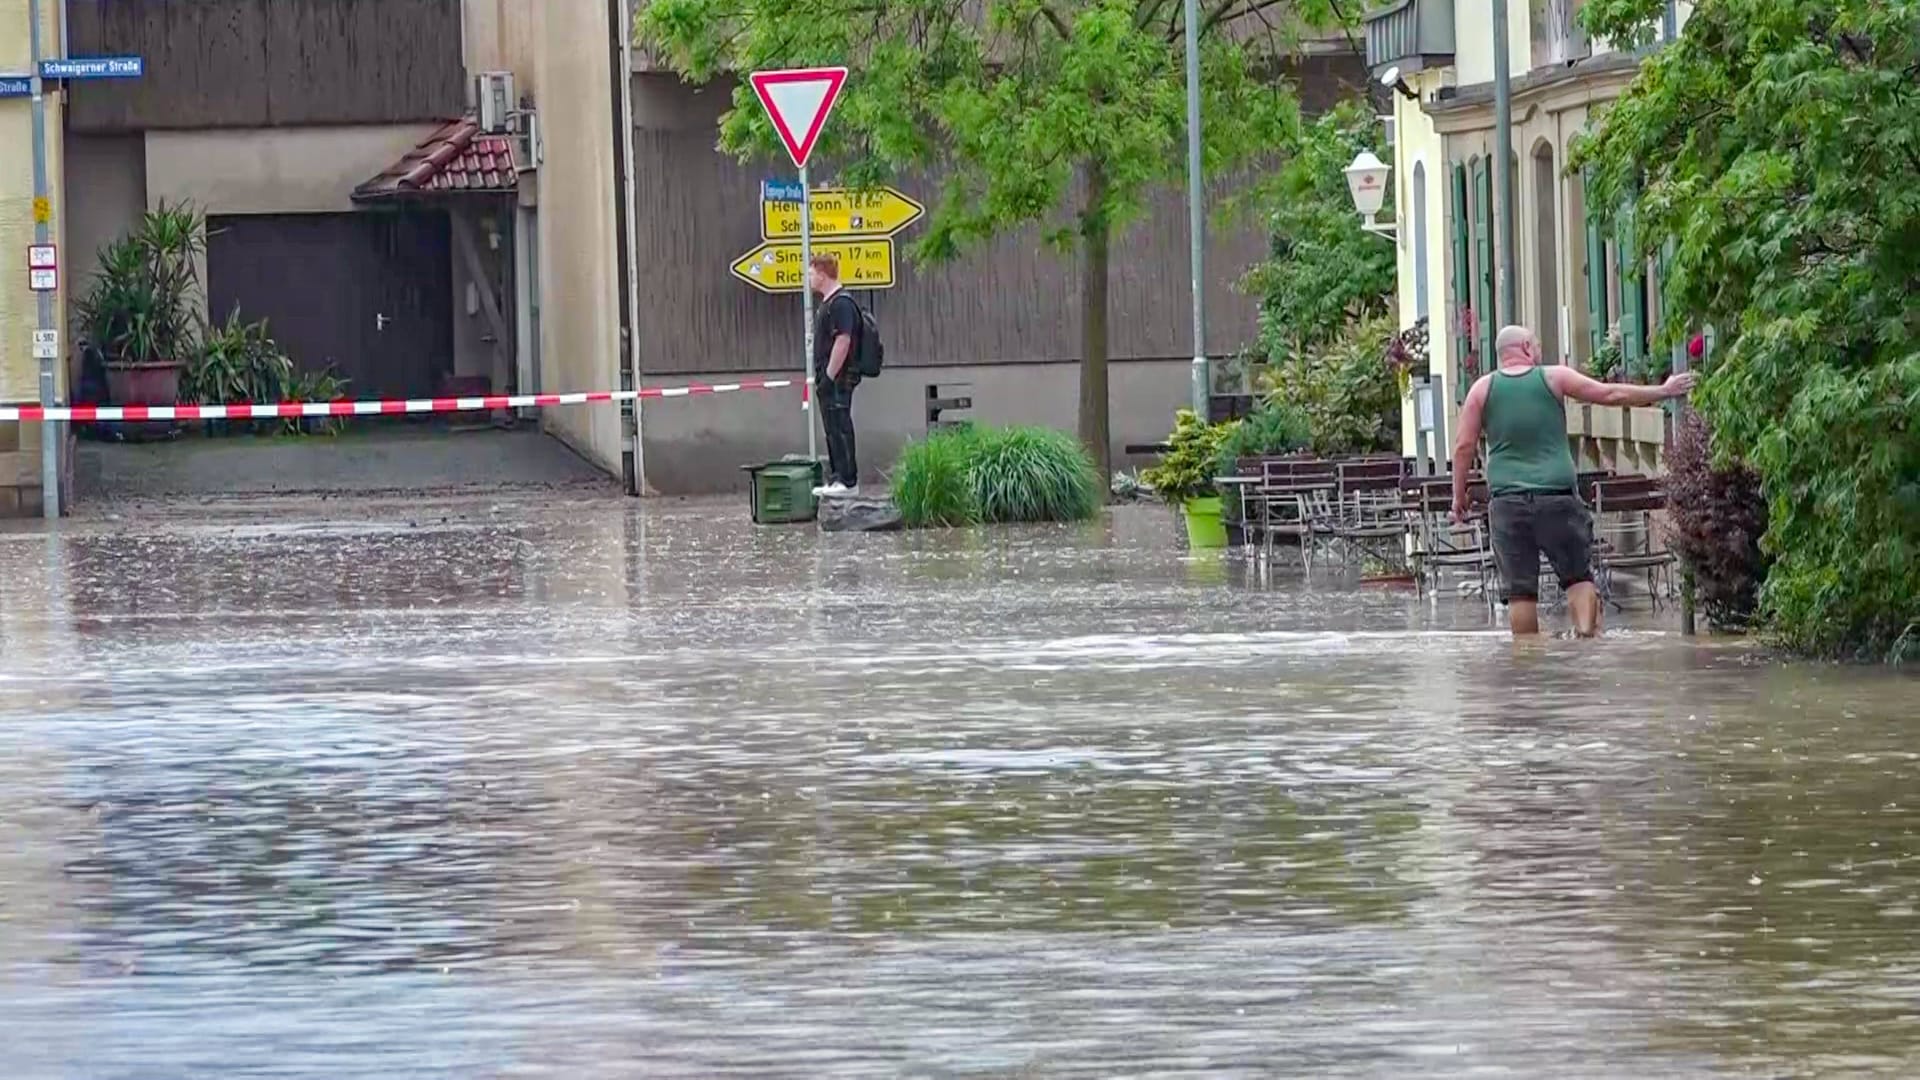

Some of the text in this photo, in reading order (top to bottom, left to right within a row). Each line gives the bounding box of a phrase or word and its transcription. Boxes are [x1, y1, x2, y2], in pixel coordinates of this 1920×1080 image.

[44, 60, 139, 75] Schwaigerner Straße
[0, 81, 28, 93] Straße
[772, 200, 842, 212] Heilronn
[866, 198, 882, 209] km
[866, 219, 884, 229] km
[848, 247, 861, 260] 17
[865, 249, 882, 260] km
[776, 267, 884, 284] Rich 4 km
